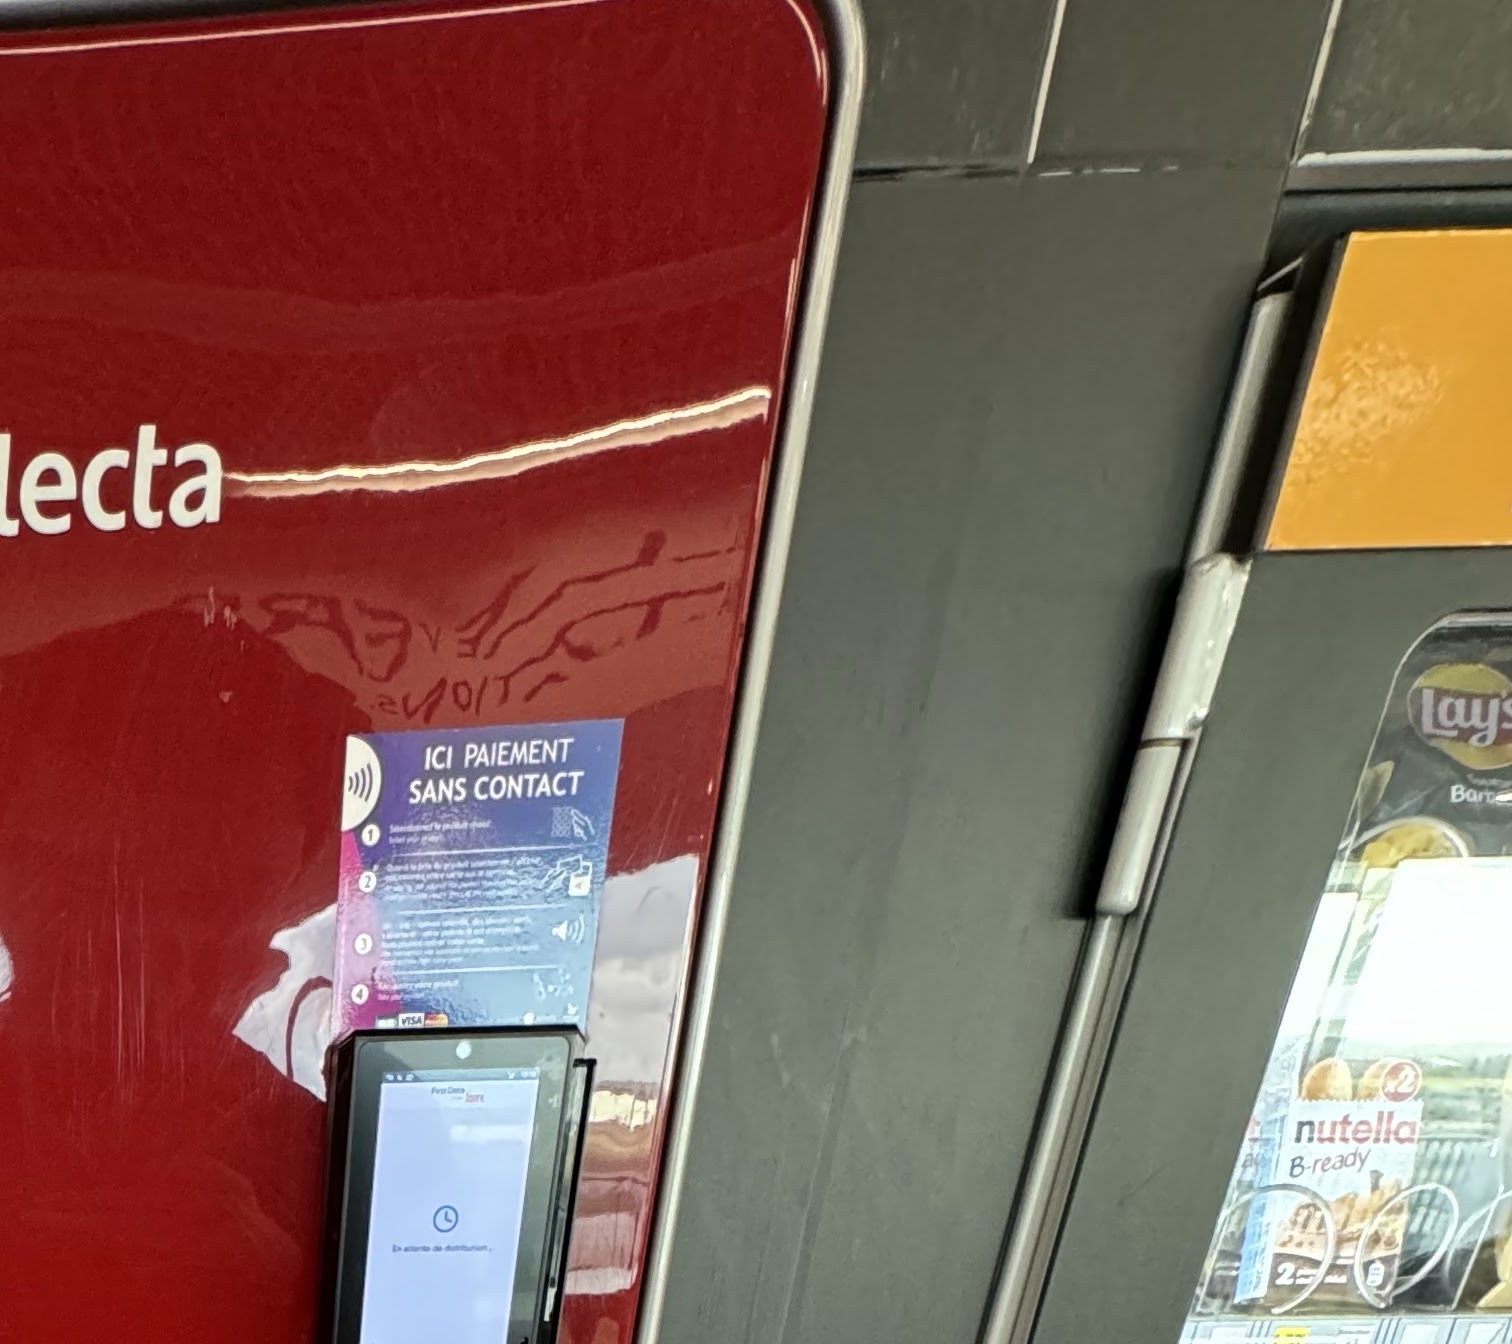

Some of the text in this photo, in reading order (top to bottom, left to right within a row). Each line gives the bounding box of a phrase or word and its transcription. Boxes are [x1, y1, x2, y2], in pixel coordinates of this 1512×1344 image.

[424, 738, 575, 771] ICI PAIEMENT
[408, 771, 585, 804] SANS CONTACT
[1294, 1111, 1417, 1144] nutella
[1289, 1146, 1371, 1179] B-ready
